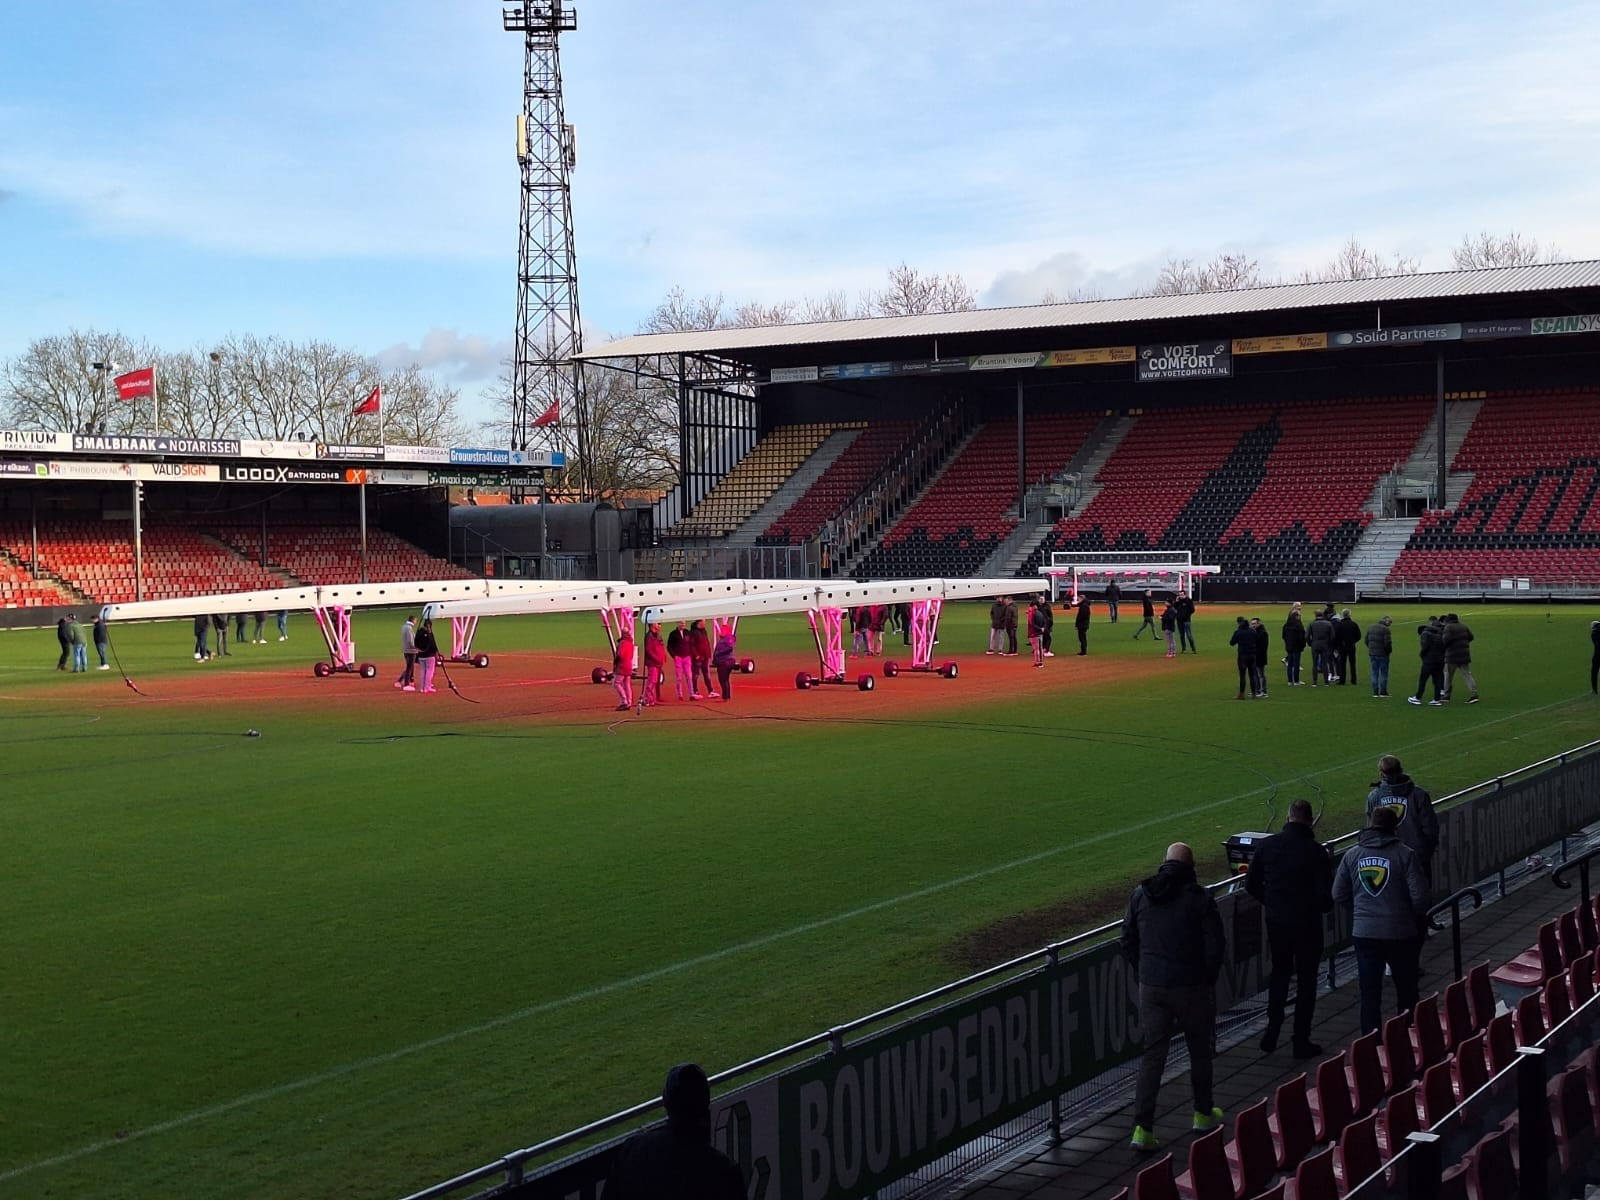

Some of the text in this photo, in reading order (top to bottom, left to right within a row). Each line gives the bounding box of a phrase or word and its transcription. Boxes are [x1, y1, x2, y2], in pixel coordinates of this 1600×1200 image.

[1355, 328, 1447, 343] Solid Partners
[1164, 344, 1199, 359] VOET
[1149, 354, 1216, 371] COMFORT
[1141, 367, 1228, 379] WWW.VOETCOMFORT.NL
[0, 431, 56, 445] RIVIUM
[75, 436, 156, 451] SMALBRAAK
[169, 439, 239, 453] NOTARISSEN
[152, 463, 206, 476] VALIDSIGN
[288, 471, 340, 480] BATHROOMS
[439, 473, 460, 485] maxi
[462, 476, 477, 485] zoo
[510, 474, 545, 485] maxi zoo
[799, 973, 1082, 1200] BOUWBEDRIJF
